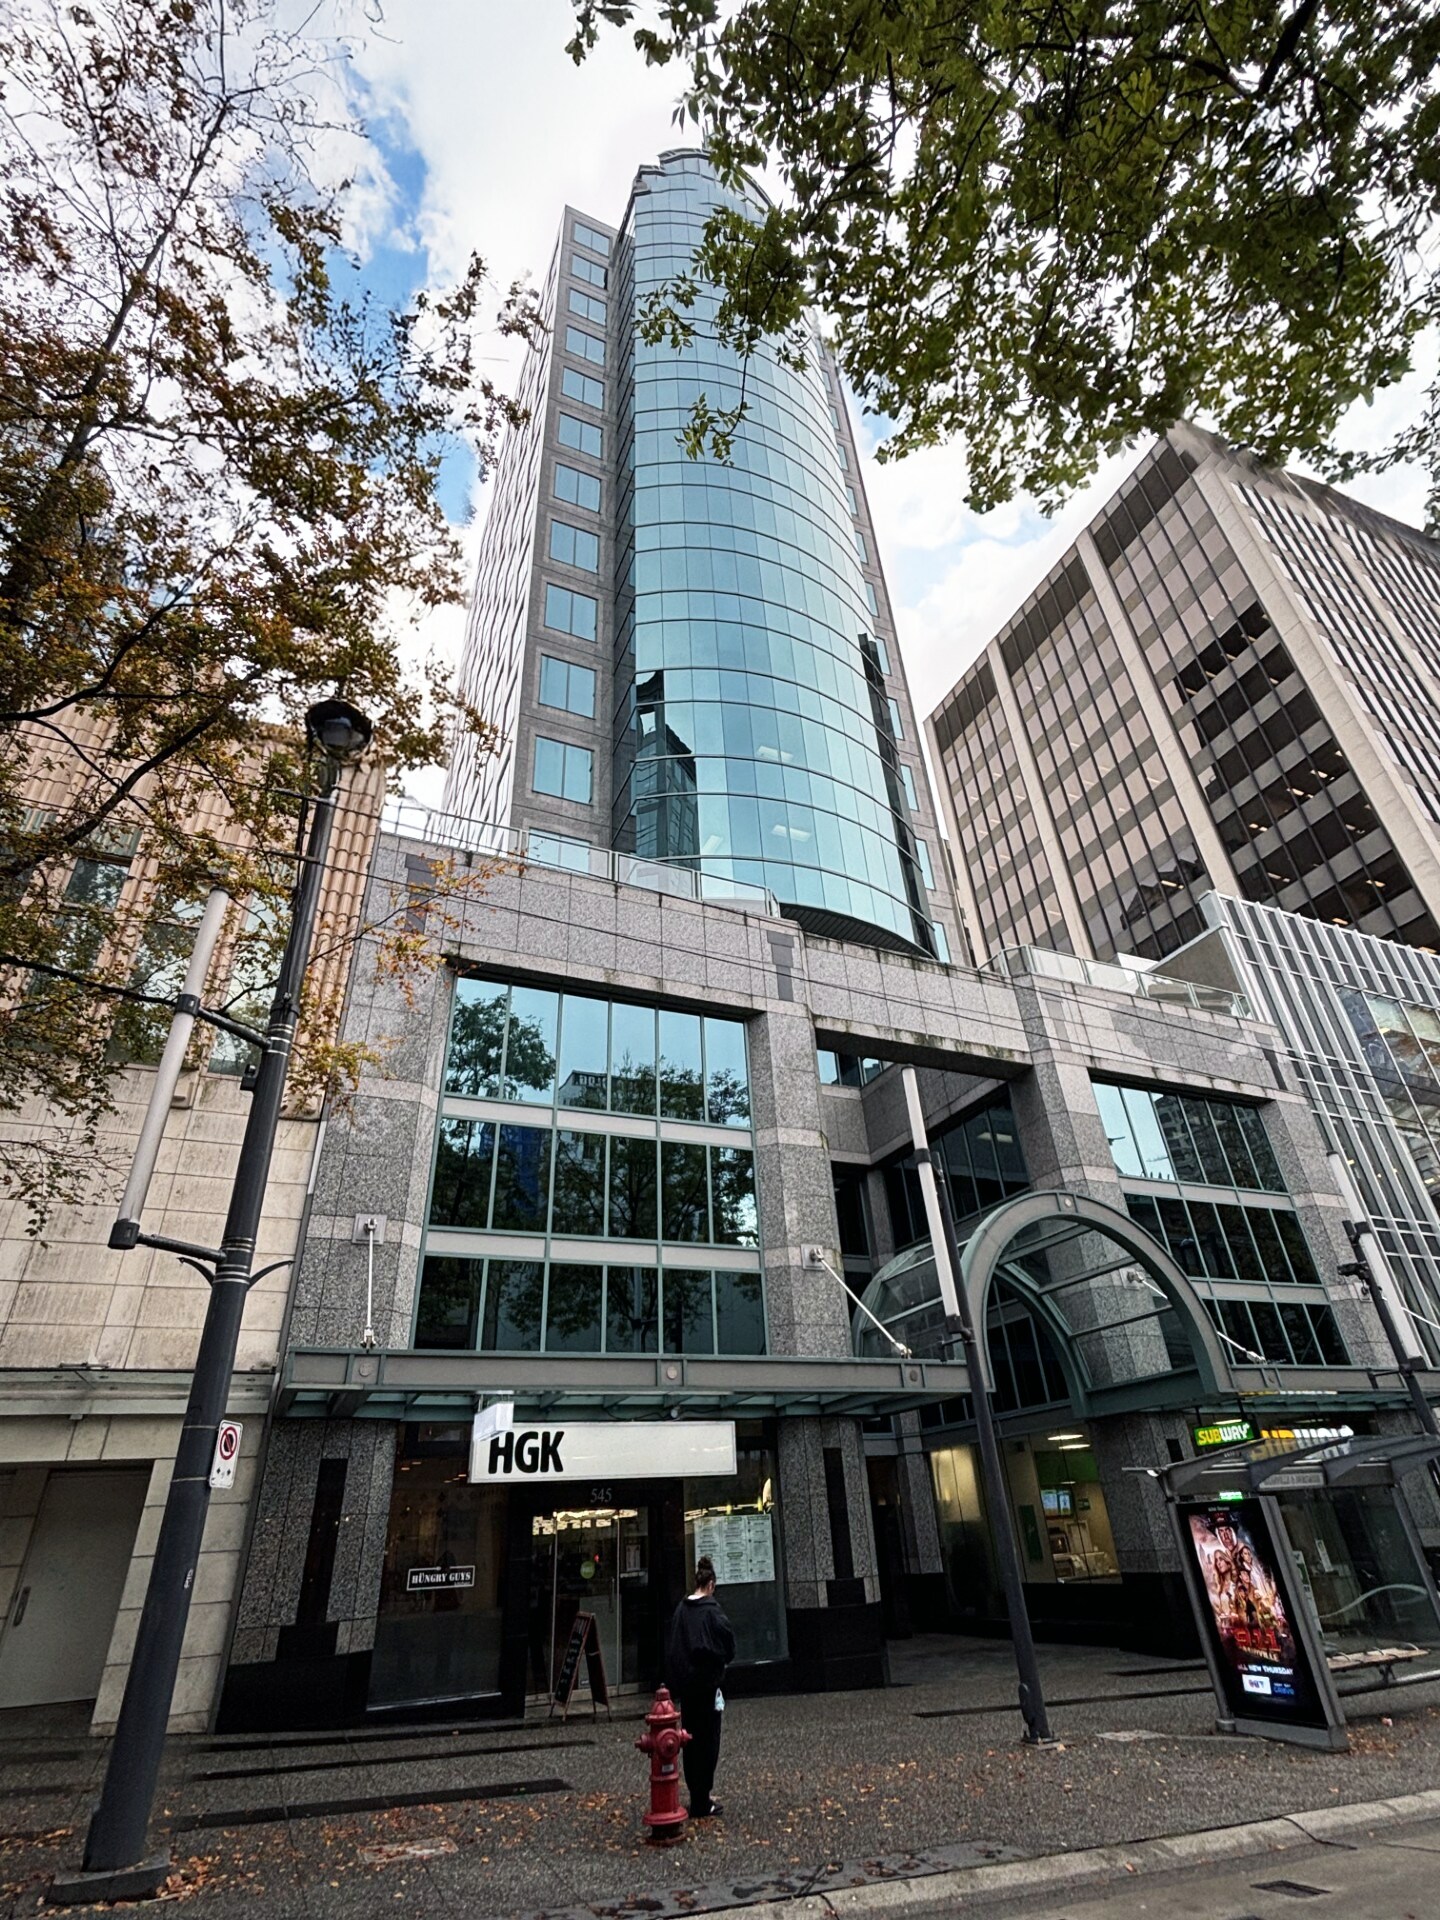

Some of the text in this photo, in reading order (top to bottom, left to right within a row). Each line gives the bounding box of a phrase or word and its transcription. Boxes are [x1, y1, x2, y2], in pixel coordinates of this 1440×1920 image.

[1197, 1423, 1250, 1446] SUBWAY
[488, 1430, 565, 1474] HGK
[590, 1488, 613, 1503] 545
[449, 1571, 471, 1582] GUYS
[1248, 1664, 1262, 1672] NEW
[1262, 1665, 1293, 1675] THURSDAY
